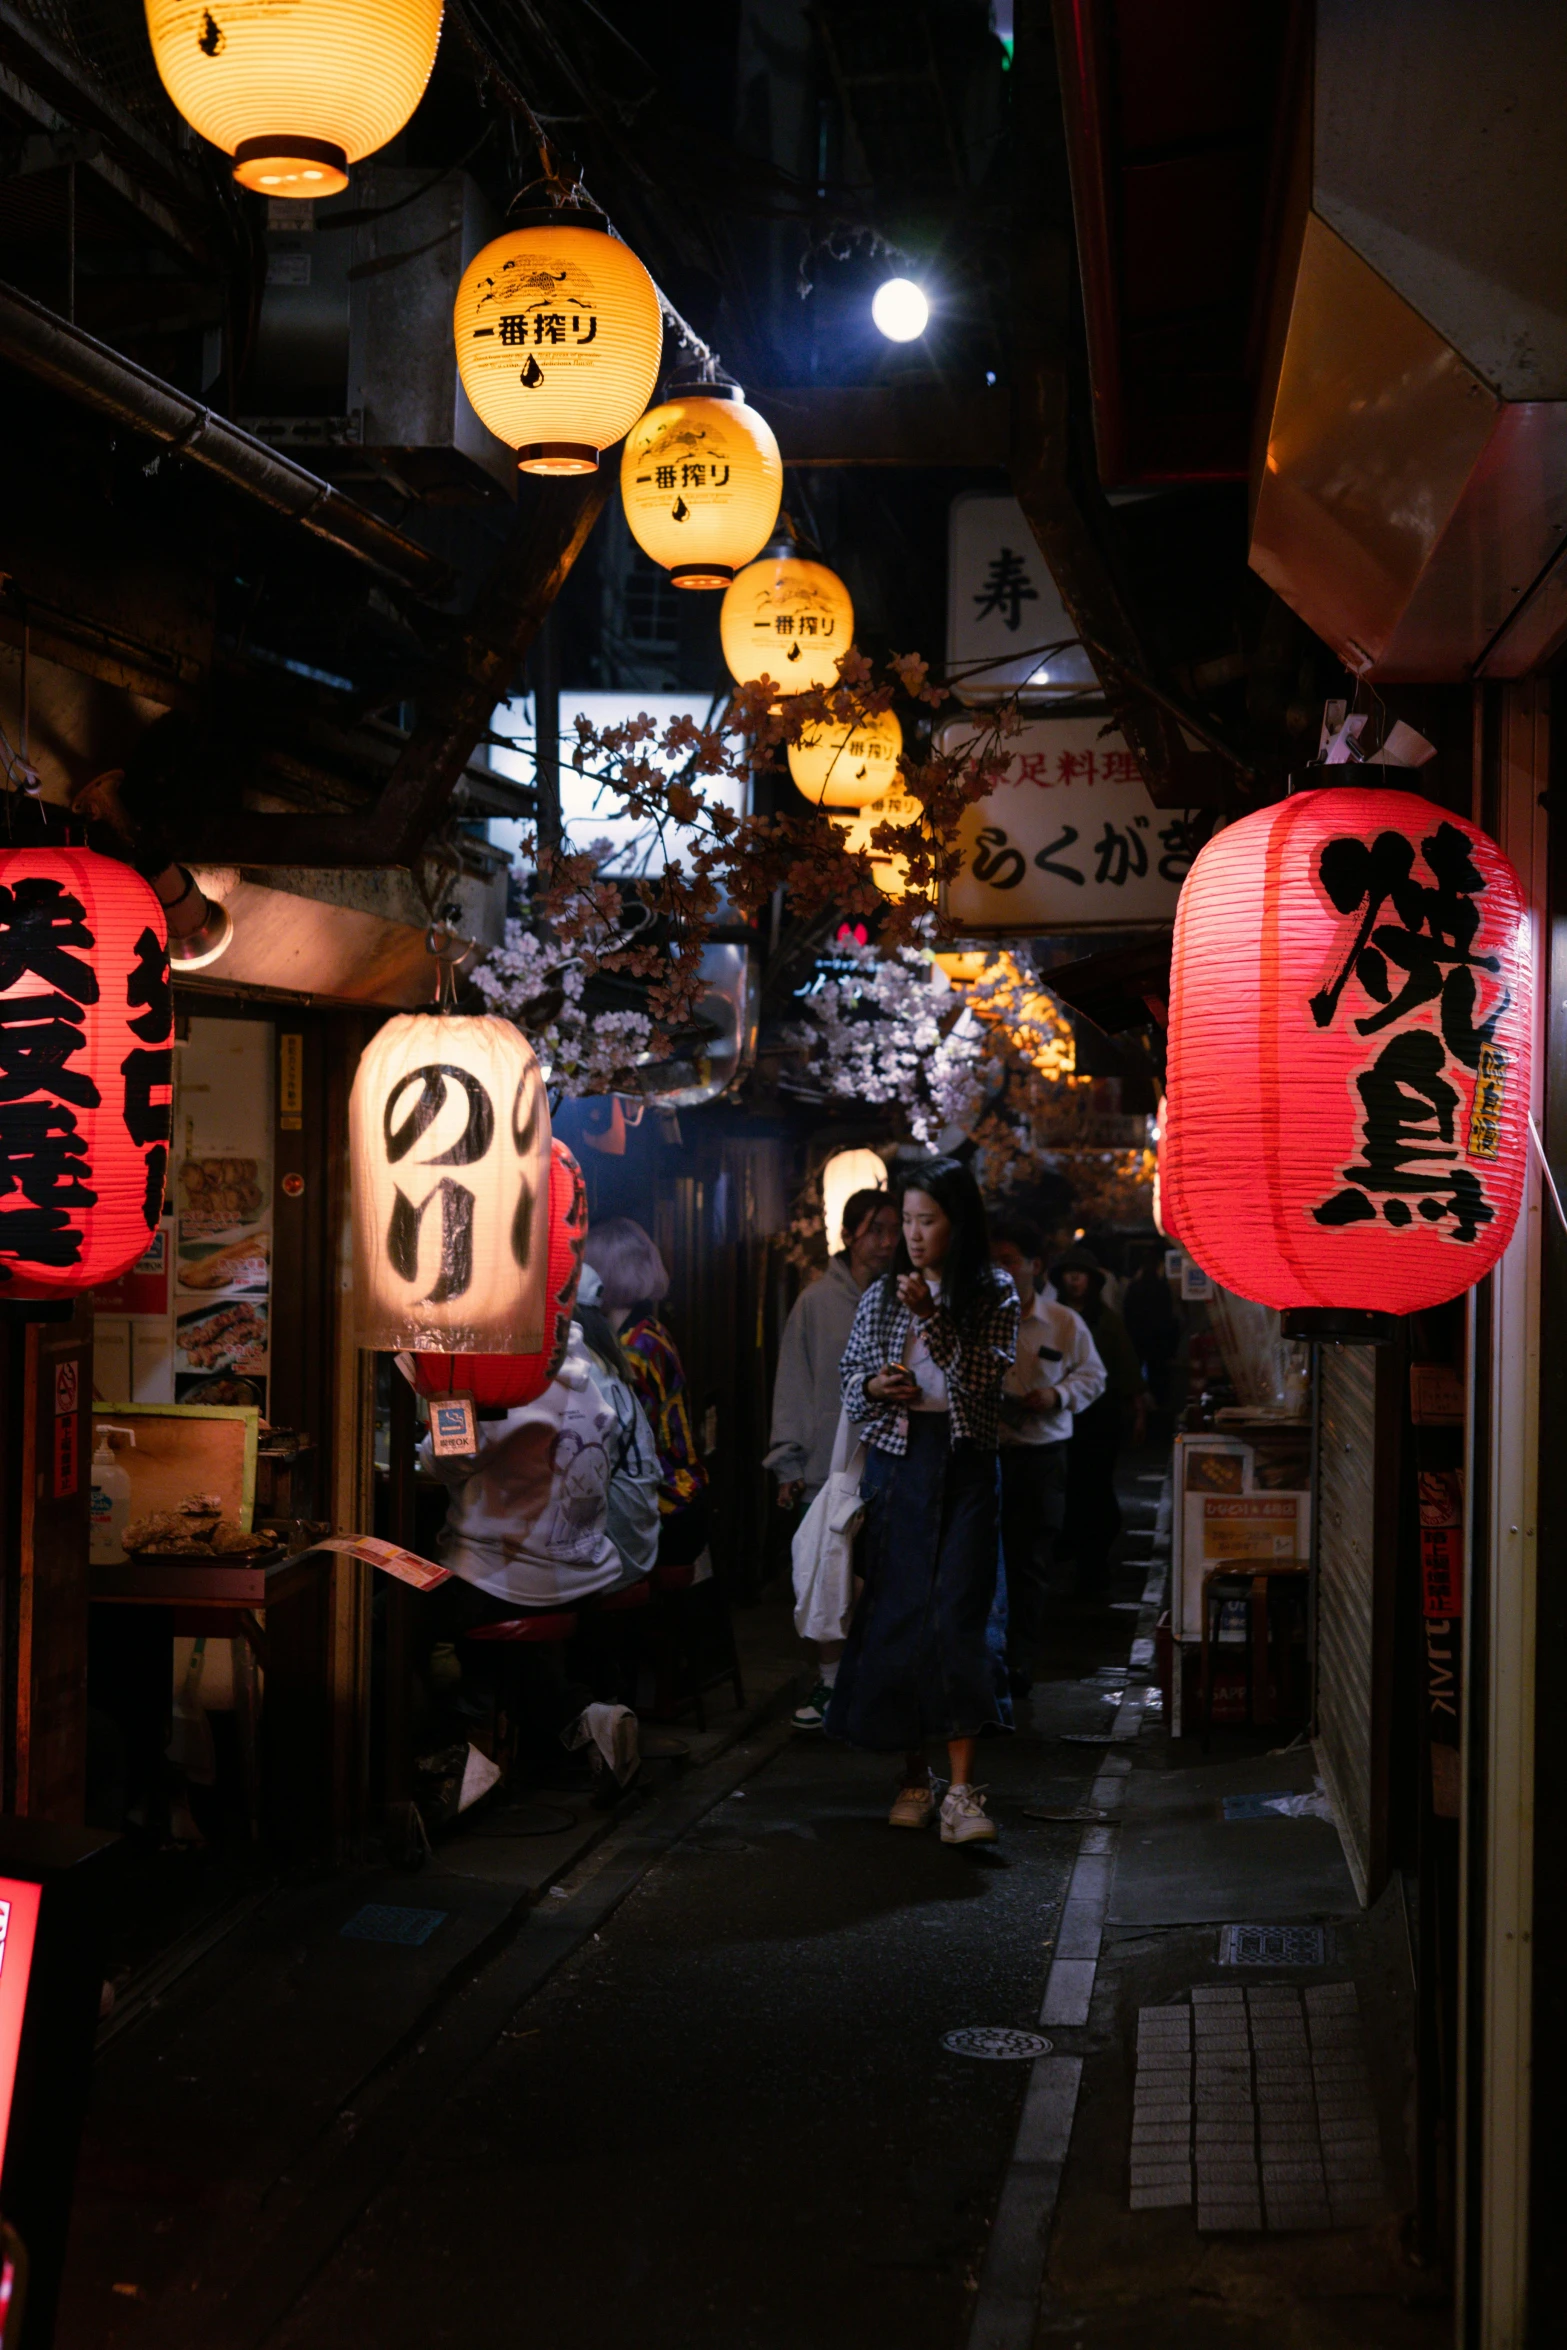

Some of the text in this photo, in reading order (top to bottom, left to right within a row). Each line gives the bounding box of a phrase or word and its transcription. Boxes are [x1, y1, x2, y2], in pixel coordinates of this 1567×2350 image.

[473, 314, 597, 346] 一番搾り
[636, 464, 730, 489] 一番搾り
[973, 549, 1039, 632] 寿
[754, 615, 836, 637] 一番搾り
[1309, 821, 1511, 1243] 焼鳥
[383, 1063, 495, 1306] のり
